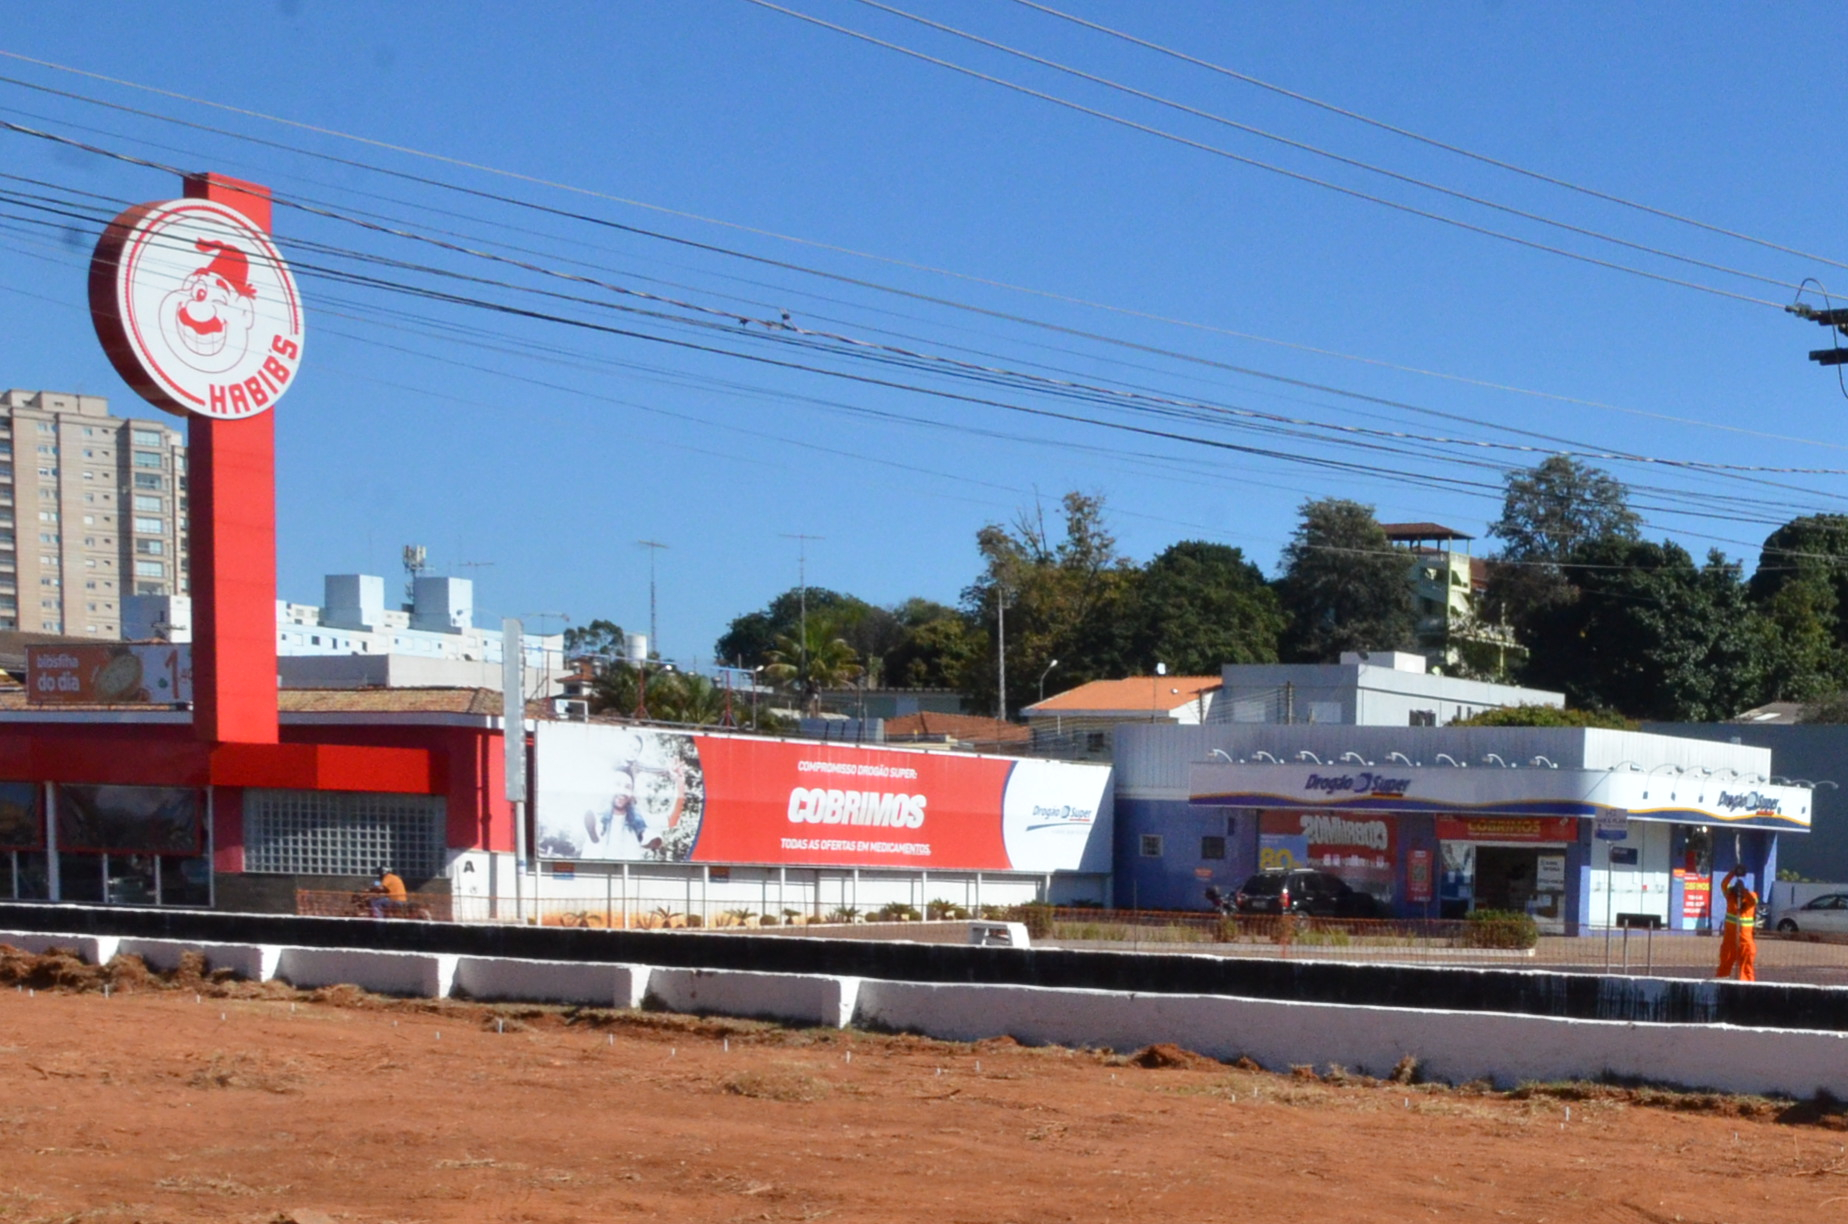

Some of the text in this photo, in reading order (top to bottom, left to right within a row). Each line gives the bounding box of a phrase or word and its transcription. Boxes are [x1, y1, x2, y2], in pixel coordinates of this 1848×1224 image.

[208, 334, 298, 414] HABIB'S
[37, 671, 81, 692] do dia
[798, 760, 857, 775] COMPROMISSO
[857, 764, 889, 778] DROGÃO
[1305, 773, 1411, 795] Drogão Super
[787, 786, 928, 830] COBRIMOS
[1070, 807, 1092, 820] Super
[1467, 820, 1541, 833] COBRIMOS
[780, 837, 808, 849] TODAS
[808, 838, 820, 850] AS
[821, 839, 857, 851] OFERTAS
[857, 841, 869, 852] EM
